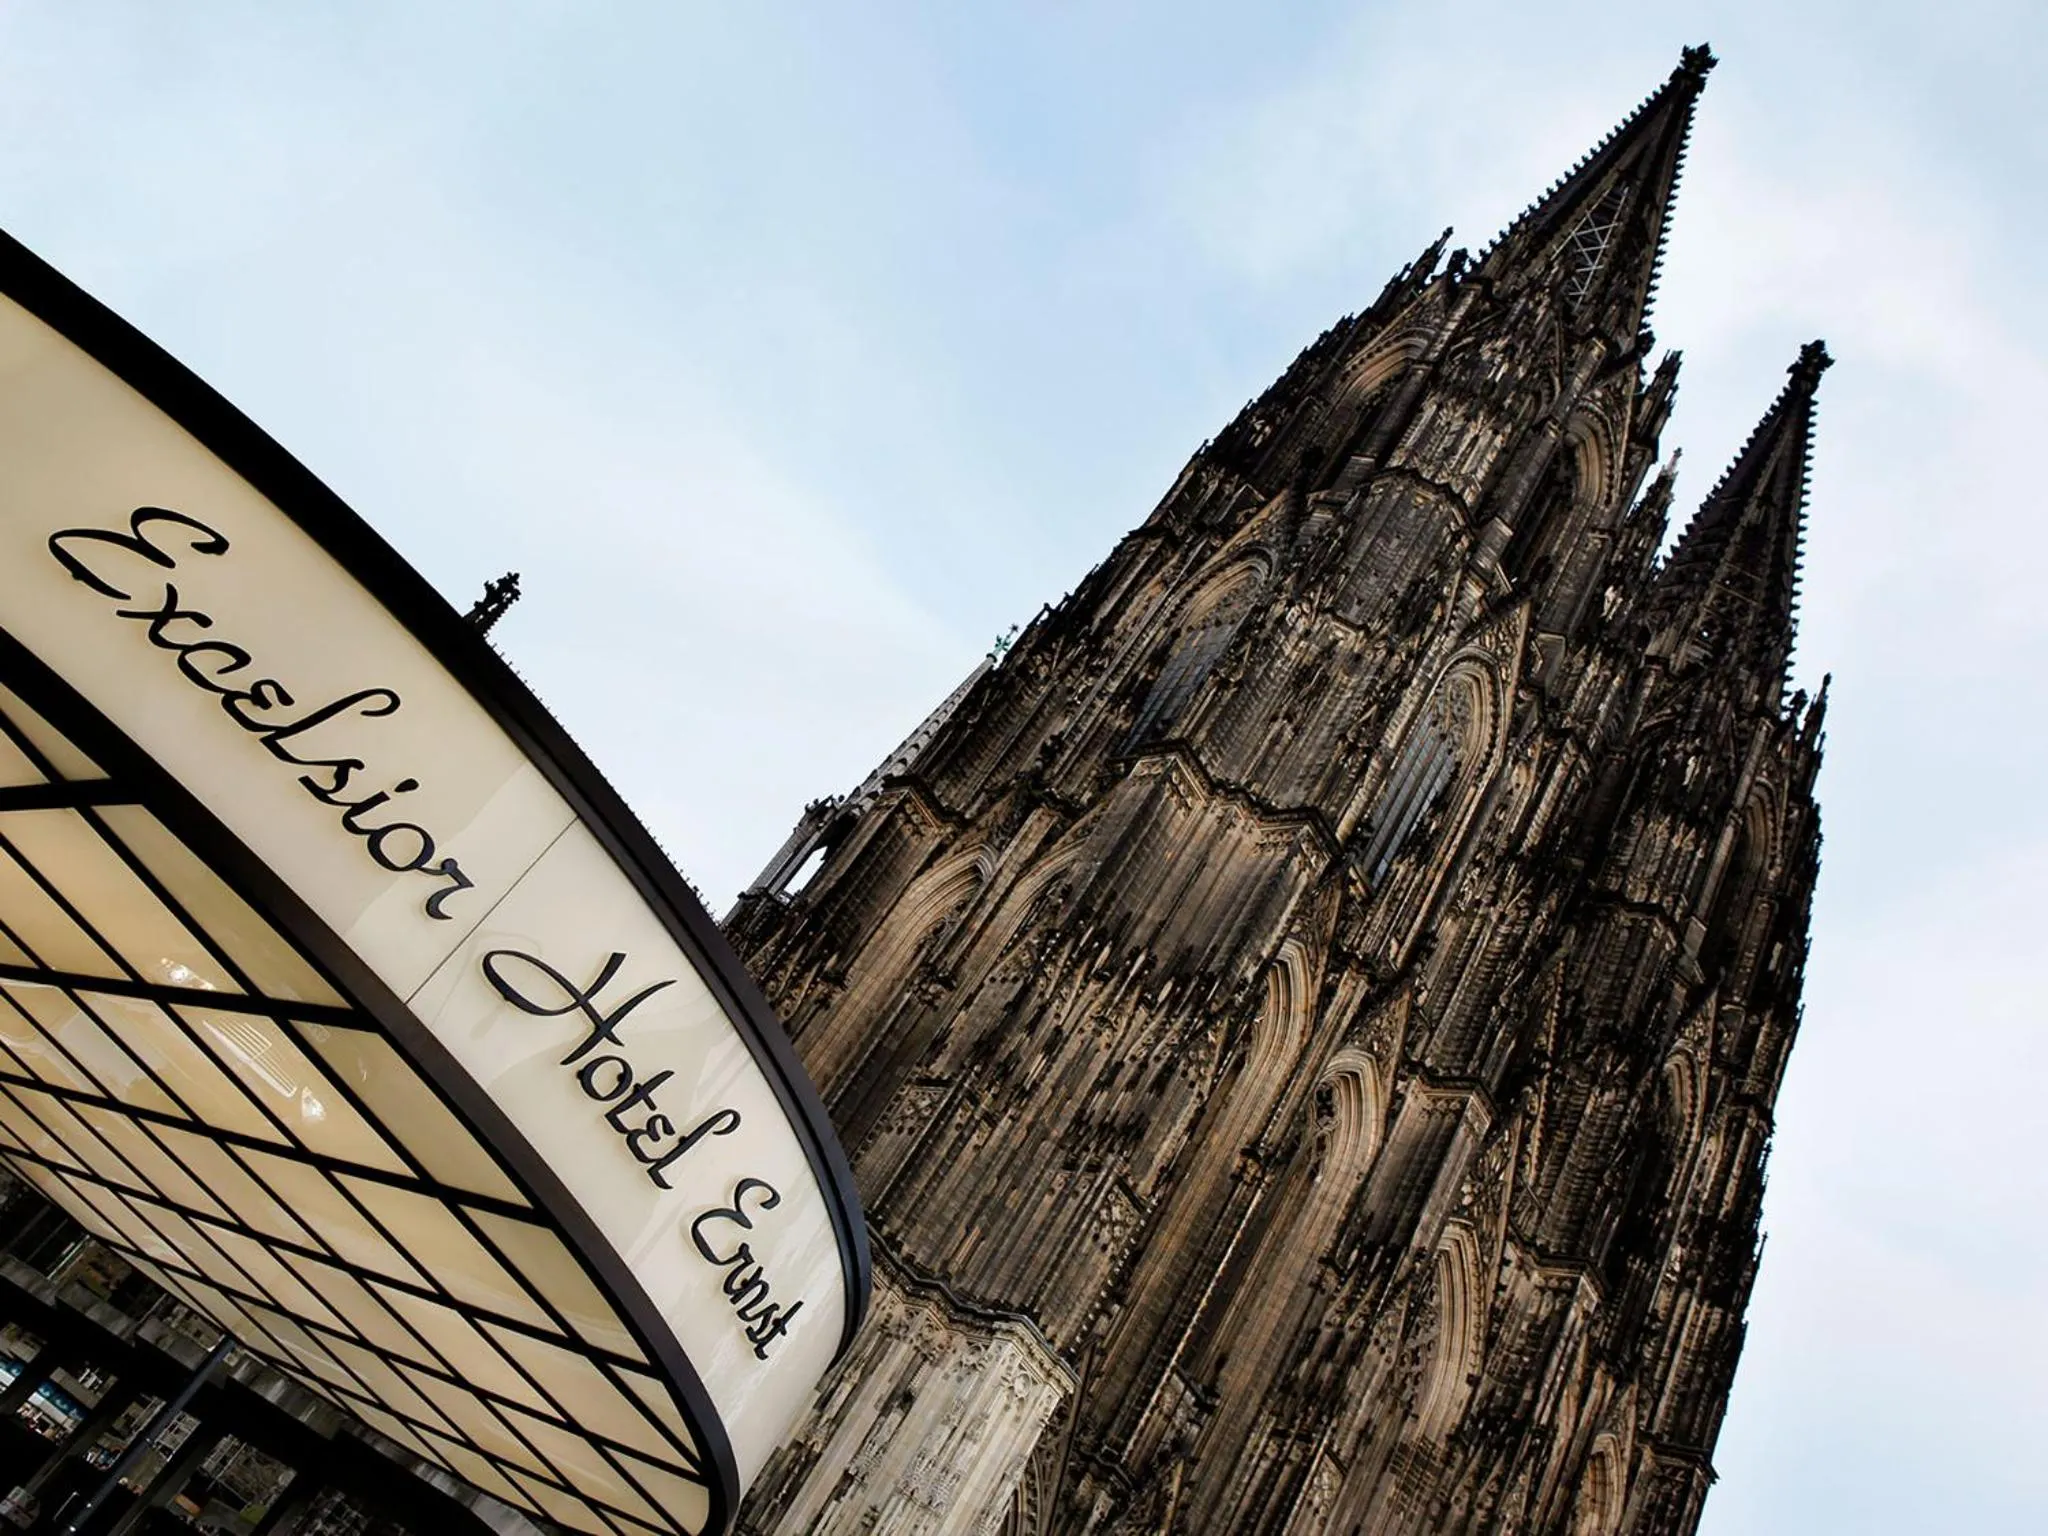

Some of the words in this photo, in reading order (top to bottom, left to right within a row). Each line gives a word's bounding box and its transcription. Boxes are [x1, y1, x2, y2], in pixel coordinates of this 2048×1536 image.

[48, 506, 475, 920] Excelsior
[482, 950, 741, 1190] Hotel
[690, 1178, 804, 1361] Ernst
